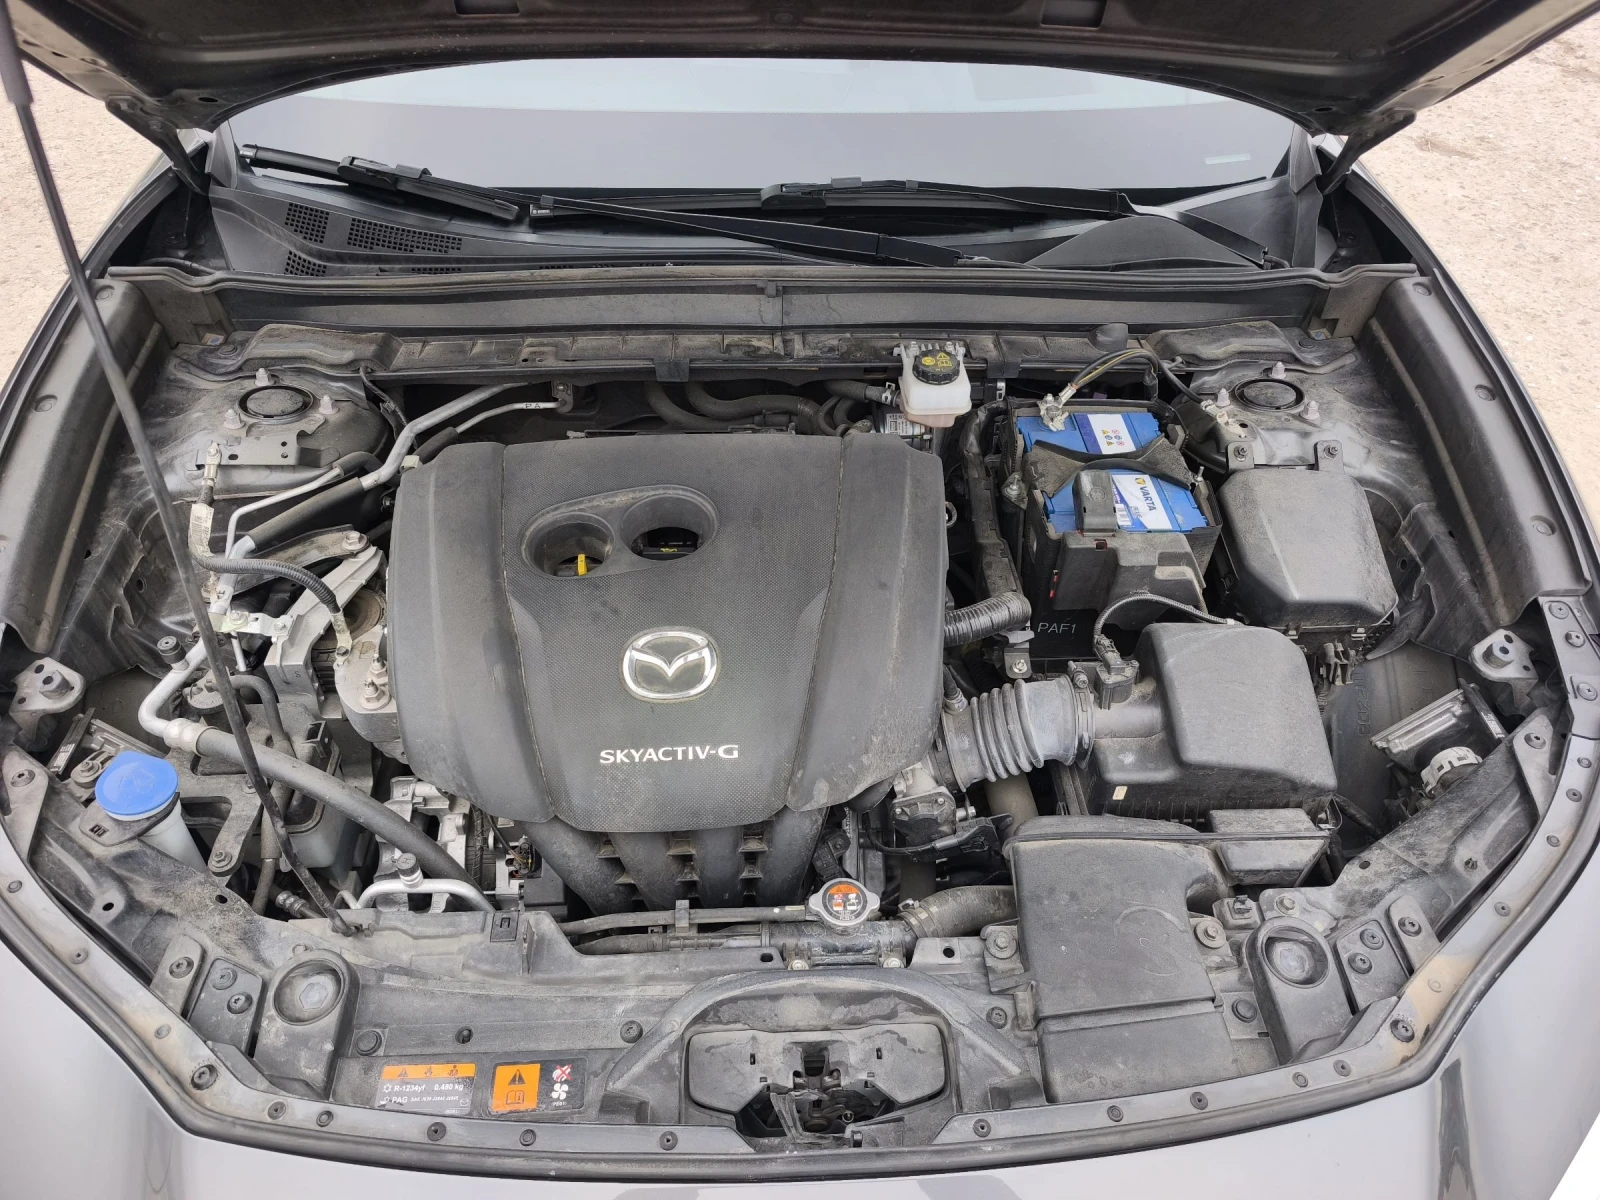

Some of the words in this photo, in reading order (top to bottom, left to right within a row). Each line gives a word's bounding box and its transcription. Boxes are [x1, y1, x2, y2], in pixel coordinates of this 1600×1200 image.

[1139, 486, 1157, 511] VARTA
[1037, 622, 1076, 634] PAF1
[599, 744, 739, 764] SKYACTIV-G
[393, 1084, 426, 1093] R-1234yf
[434, 1083, 453, 1091] 0.480
[454, 1083, 464, 1091] kg
